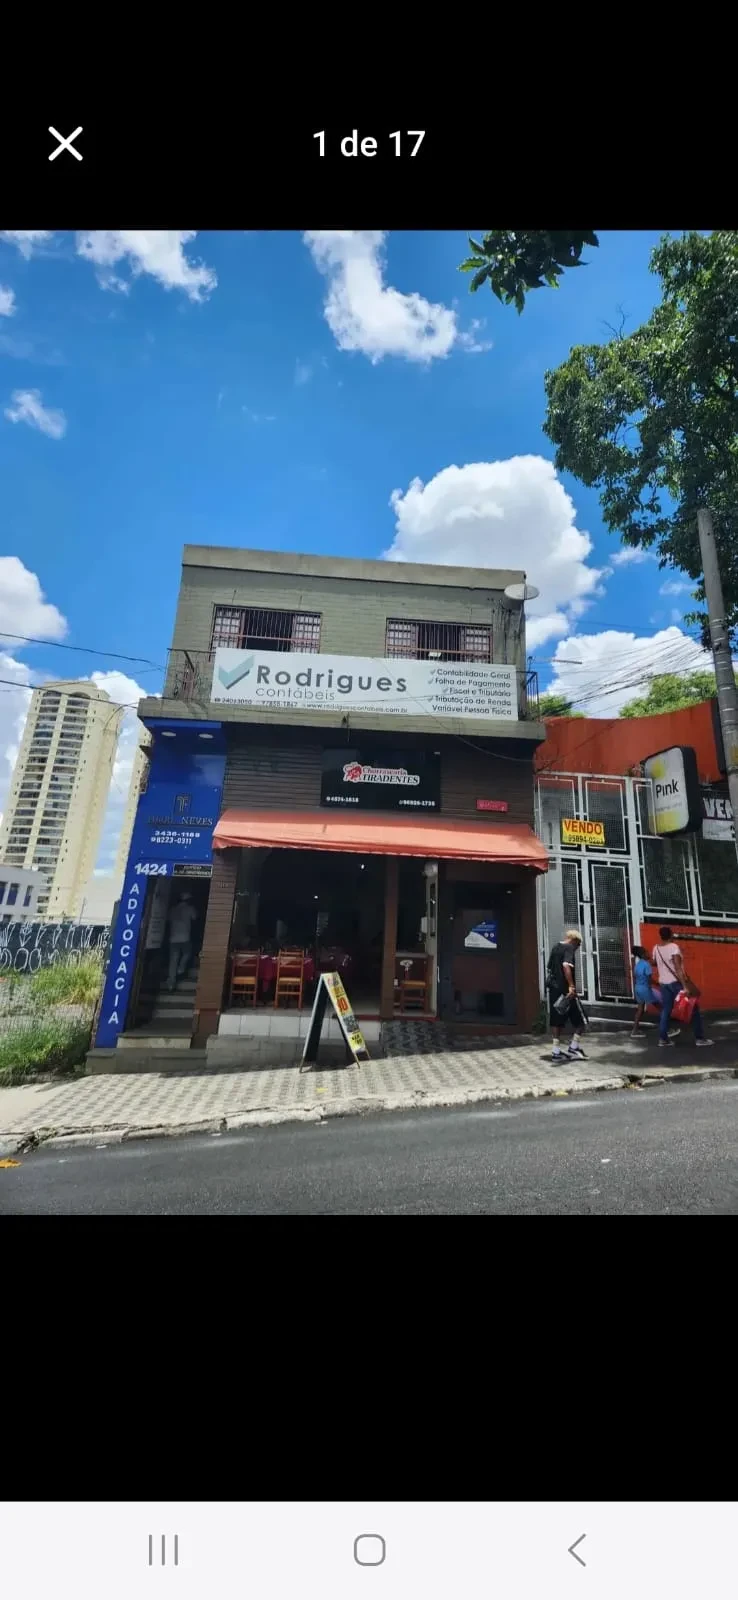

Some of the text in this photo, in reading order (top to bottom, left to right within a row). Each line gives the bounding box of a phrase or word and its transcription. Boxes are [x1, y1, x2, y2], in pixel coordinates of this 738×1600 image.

[256, 665, 408, 694] Rodrigues
[436, 668, 511, 680] Contabilidade Geral
[435, 677, 455, 685] Folha
[468, 679, 511, 689] Pagamento
[449, 687, 470, 696] Fiscal
[435, 695, 474, 705] Tributação
[487, 698, 512, 707] Renda
[464, 706, 490, 714] Pessoa
[362, 774, 418, 784] TIRADENTES
[655, 778, 679, 799] Pink
[181, 816, 213, 825] NEVES
[564, 820, 603, 836] VENDO
[134, 863, 168, 876] 1424
[108, 882, 140, 1025] ADVOCACIA
